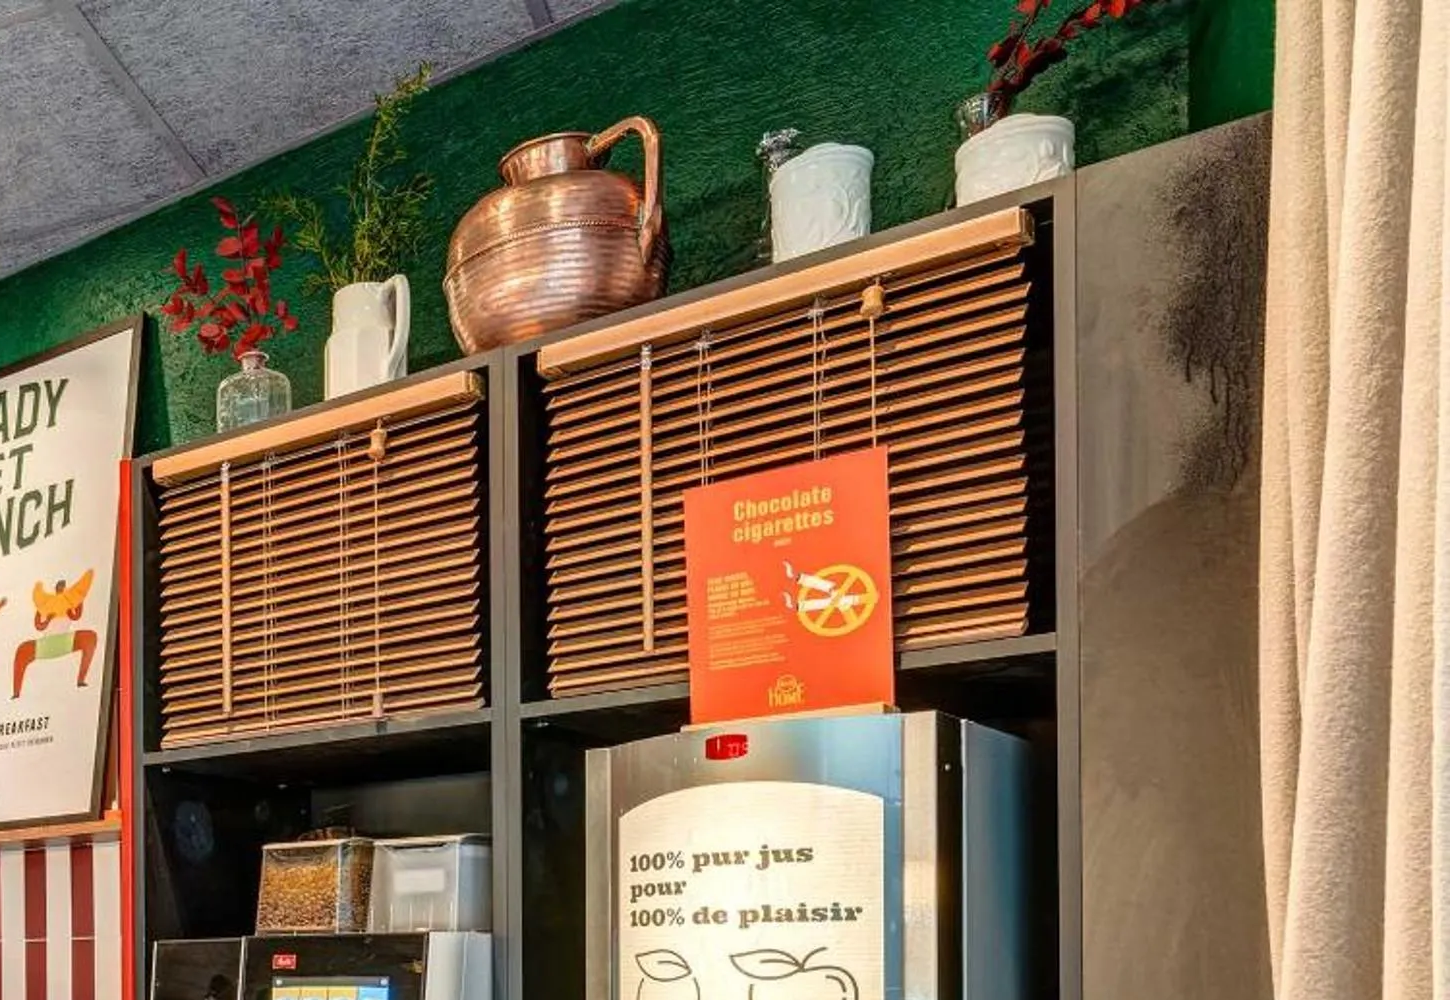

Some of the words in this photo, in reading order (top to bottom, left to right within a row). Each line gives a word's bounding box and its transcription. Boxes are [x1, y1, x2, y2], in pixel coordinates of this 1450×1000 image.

[733, 486, 832, 521] Chocolate
[733, 509, 834, 545] cigarettes
[630, 851, 685, 872] 100%
[692, 849, 750, 873] pur
[755, 844, 814, 870] jus
[630, 881, 687, 903] pour
[630, 907, 685, 927] 100%
[692, 906, 728, 925] de
[739, 902, 863, 929] plaisir
